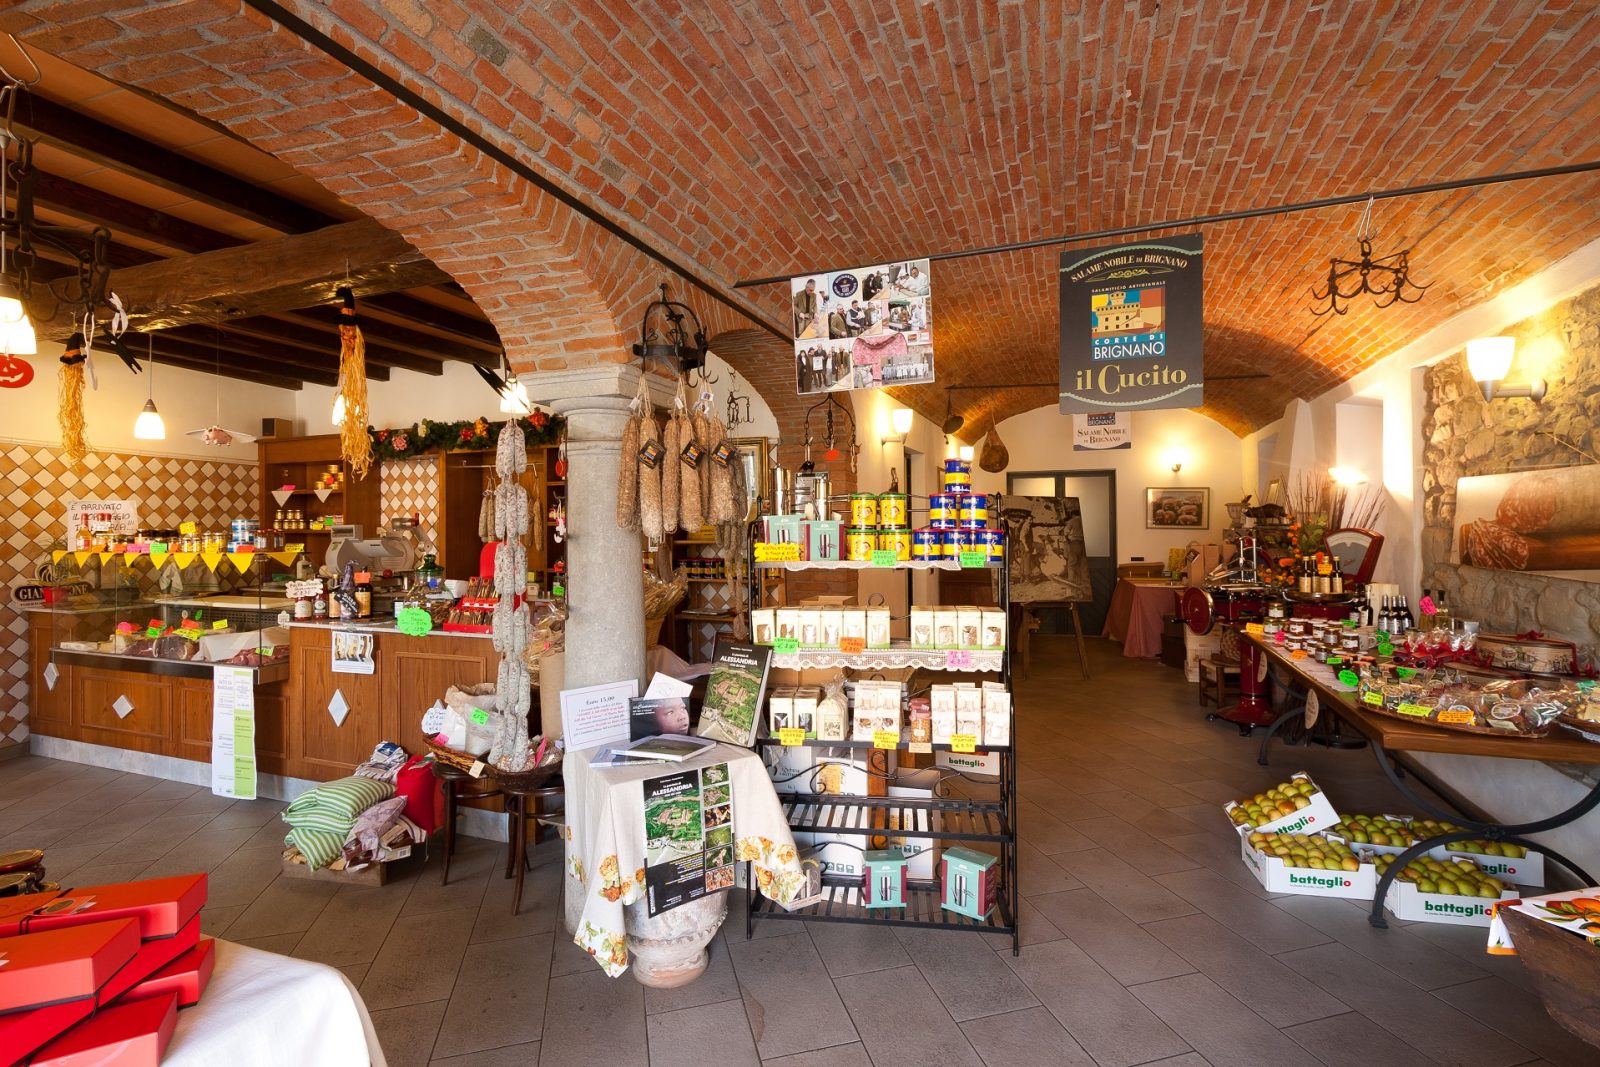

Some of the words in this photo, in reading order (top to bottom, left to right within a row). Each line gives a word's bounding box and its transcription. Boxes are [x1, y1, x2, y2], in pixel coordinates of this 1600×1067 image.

[1071, 262, 1104, 282] SALAME
[1104, 255, 1135, 268] NOBILE
[1144, 254, 1188, 268] BRIGNANO
[1091, 285, 1126, 293] SALAMIFICIO
[1095, 336, 1137, 345] CORTE
[1094, 341, 1165, 359] BRIGNANO
[1075, 369, 1093, 391] il
[1098, 364, 1187, 395] Cucito
[1090, 436, 1121, 444] BRIGNANO
[81, 503, 122, 511] ARRIVATO
[720, 655, 758, 666] ALESSANDRIA
[948, 757, 985, 767] battaglio
[652, 783, 693, 796] ALESSANDRIA
[1481, 863, 1517, 874] aglio
[1290, 874, 1352, 888] battaglio
[1425, 901, 1493, 916] battaglio
